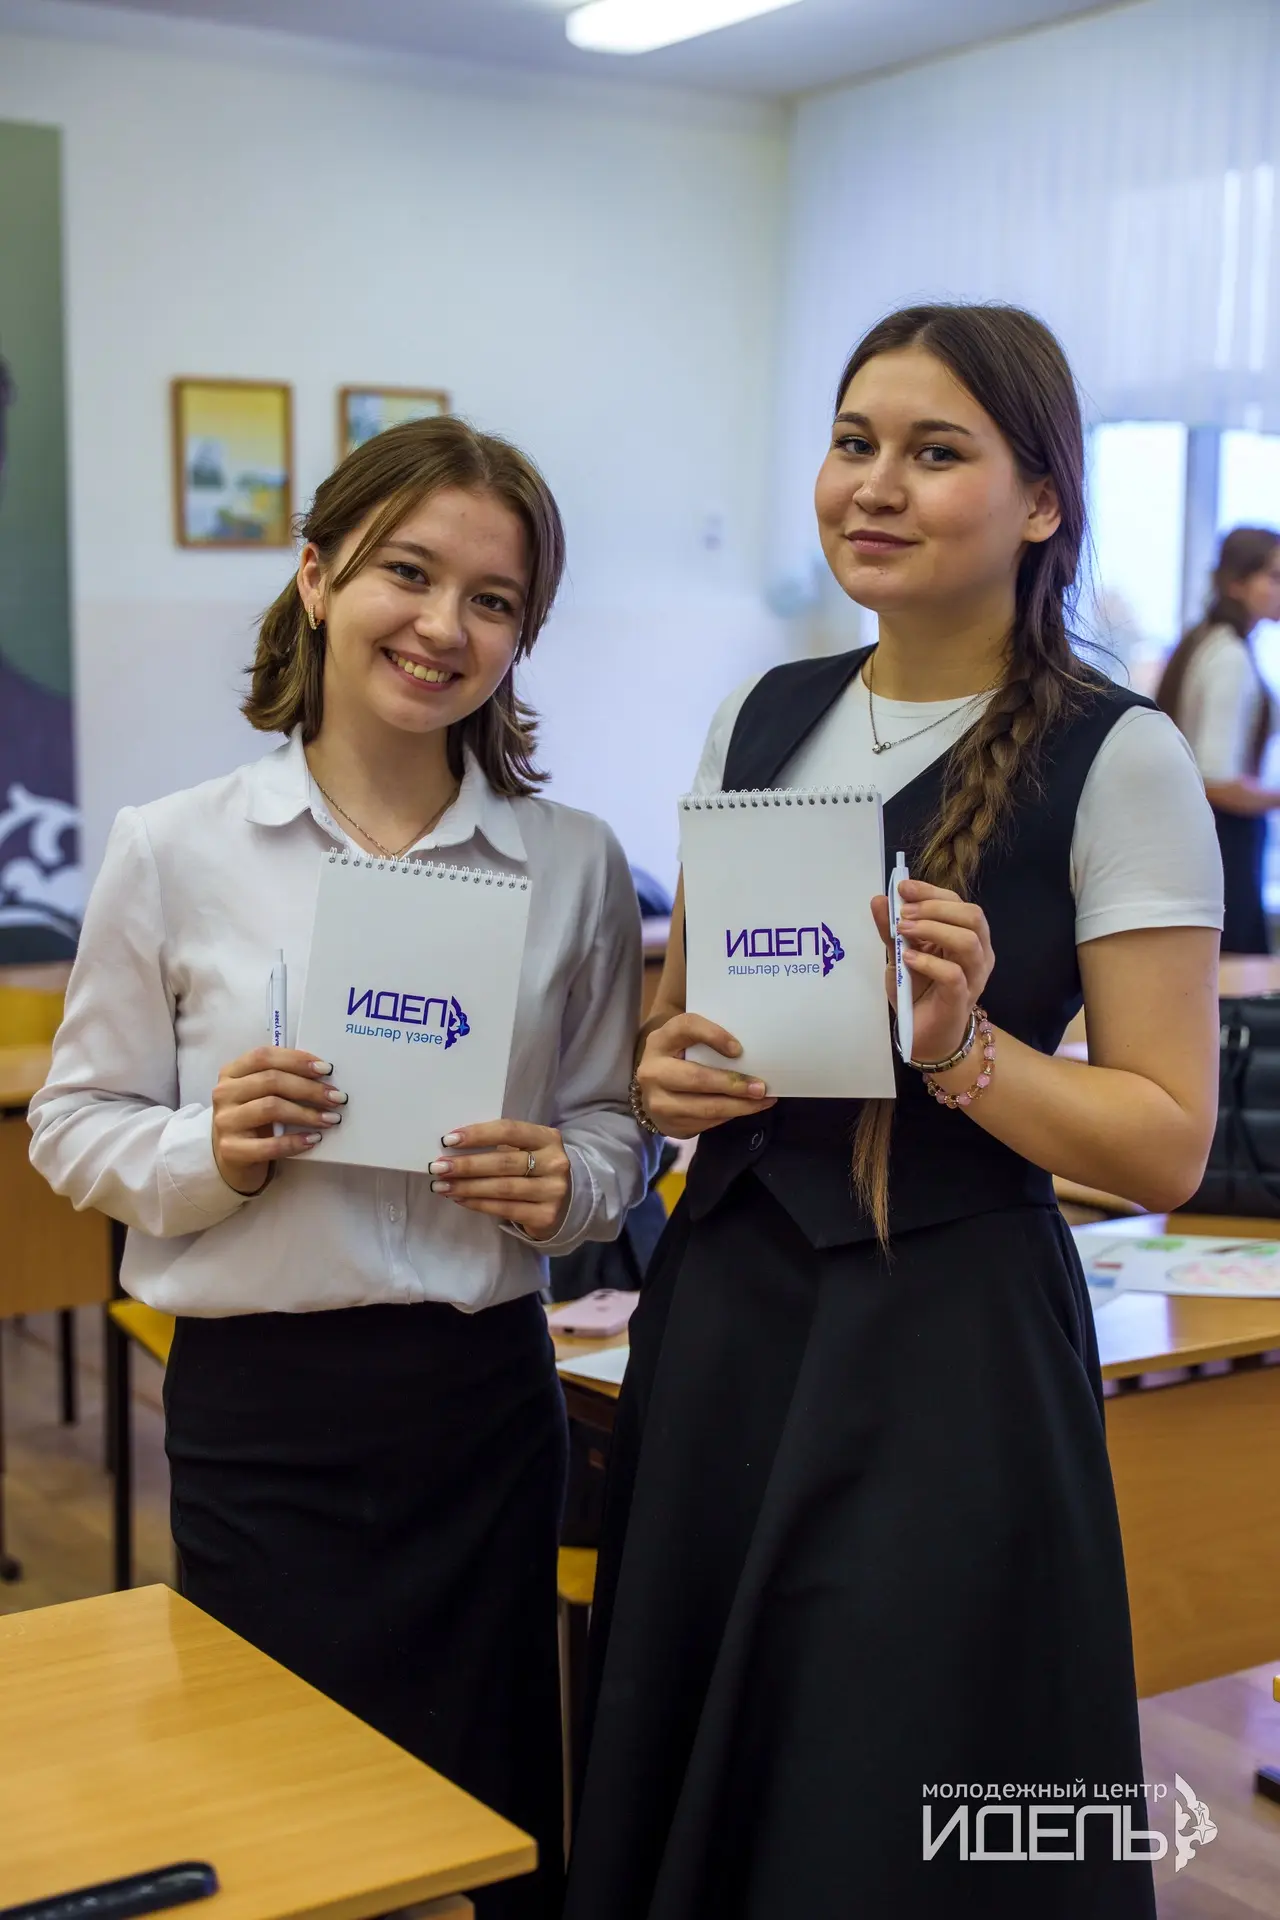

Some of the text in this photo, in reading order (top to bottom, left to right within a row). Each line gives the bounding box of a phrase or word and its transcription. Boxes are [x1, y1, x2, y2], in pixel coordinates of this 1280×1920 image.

[726, 927, 820, 957] ИДЕЛ
[728, 963, 820, 977] яшьләр үзәге
[347, 986, 449, 1028] ИДЕЛ
[345, 1023, 443, 1045] яшьләр үзәге
